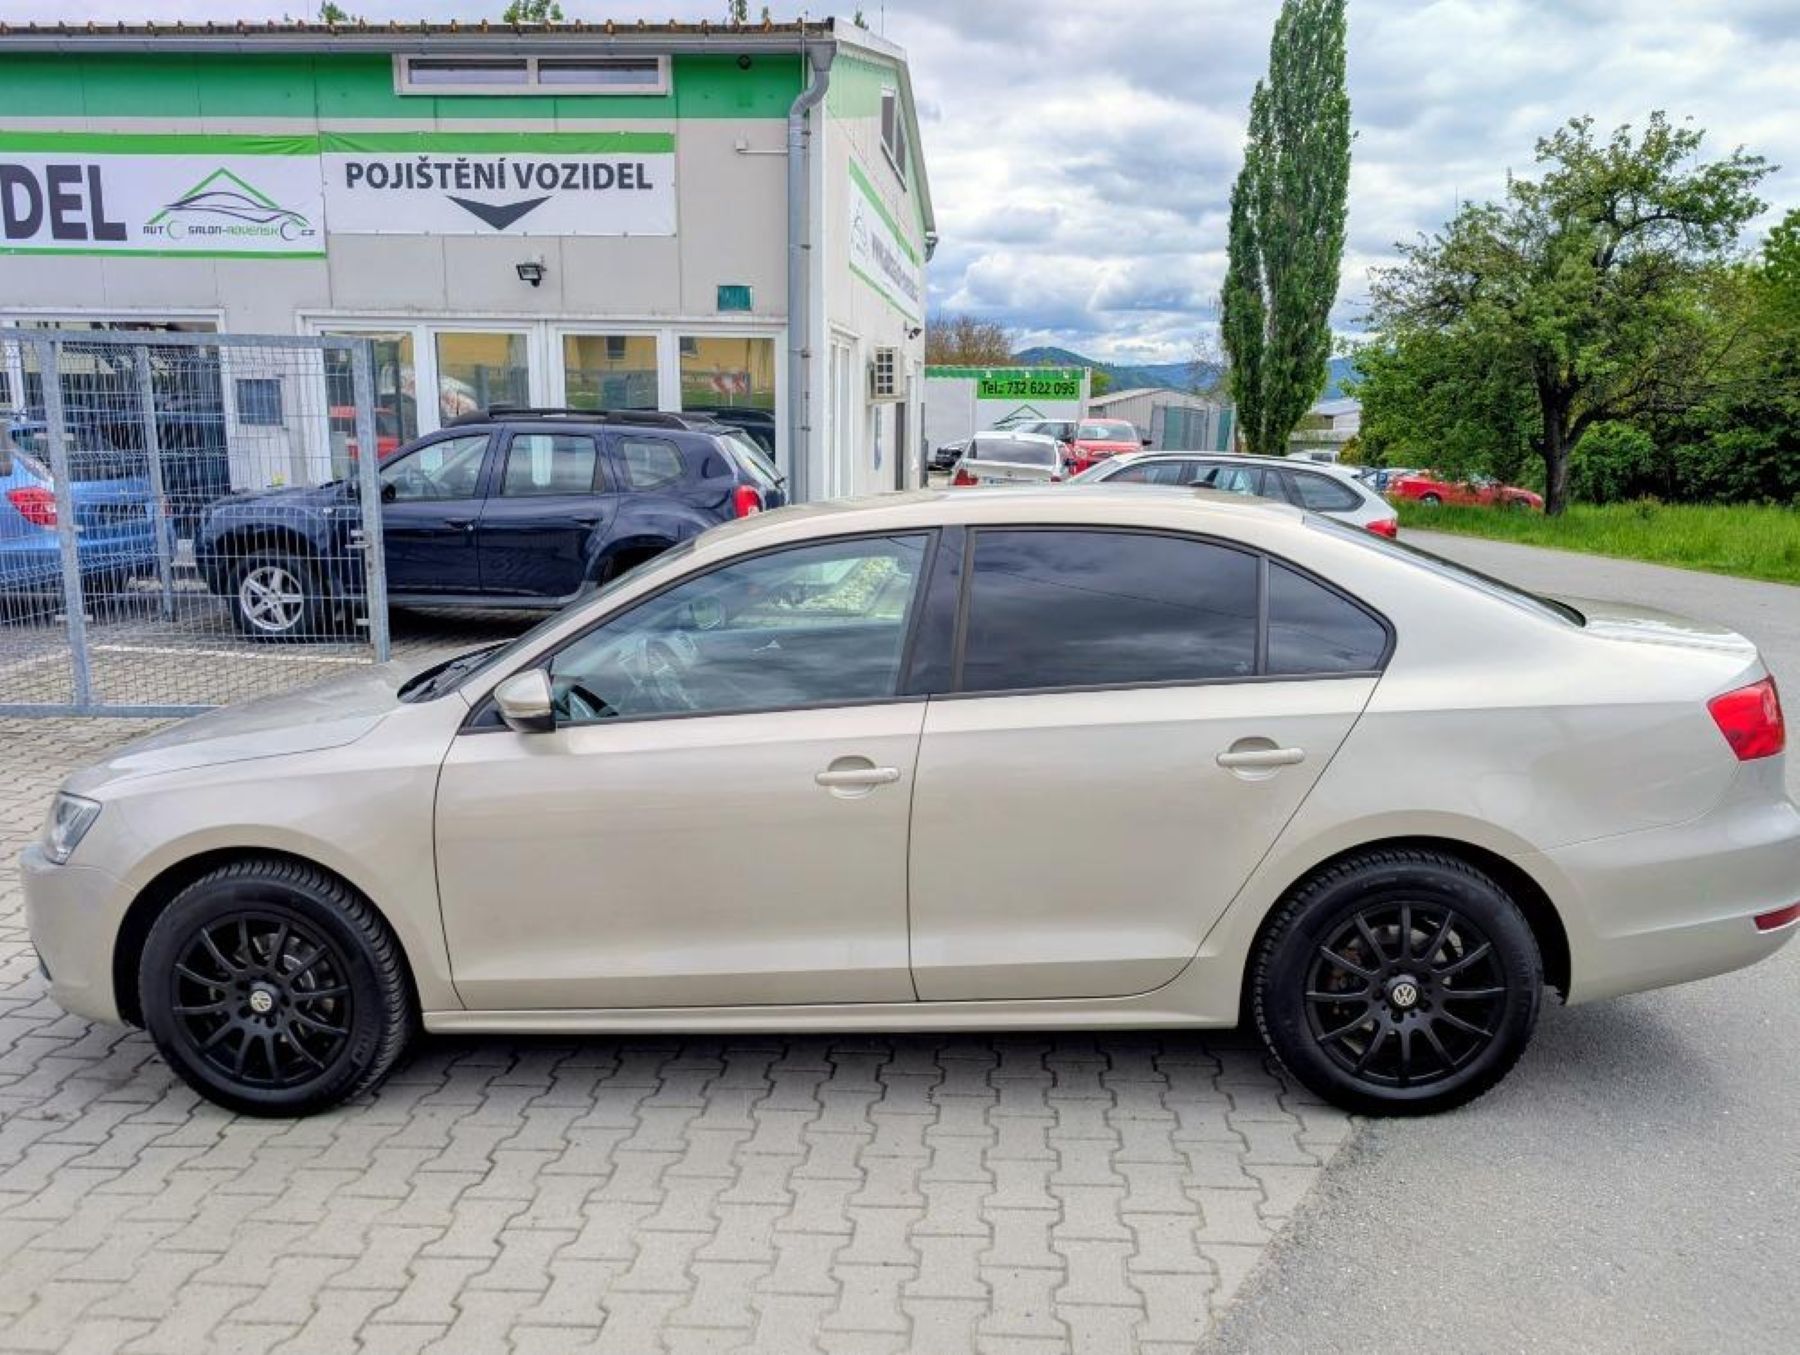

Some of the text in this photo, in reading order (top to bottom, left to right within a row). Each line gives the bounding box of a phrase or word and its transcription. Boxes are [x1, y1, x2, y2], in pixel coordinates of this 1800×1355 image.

[345, 156, 653, 190] POJIŠTĚNÍ VOZIDEL
[0, 164, 128, 241] DEL
[1007, 381, 1027, 394] 732
[1030, 381, 1051, 394] 622
[1054, 381, 1075, 395] 095
